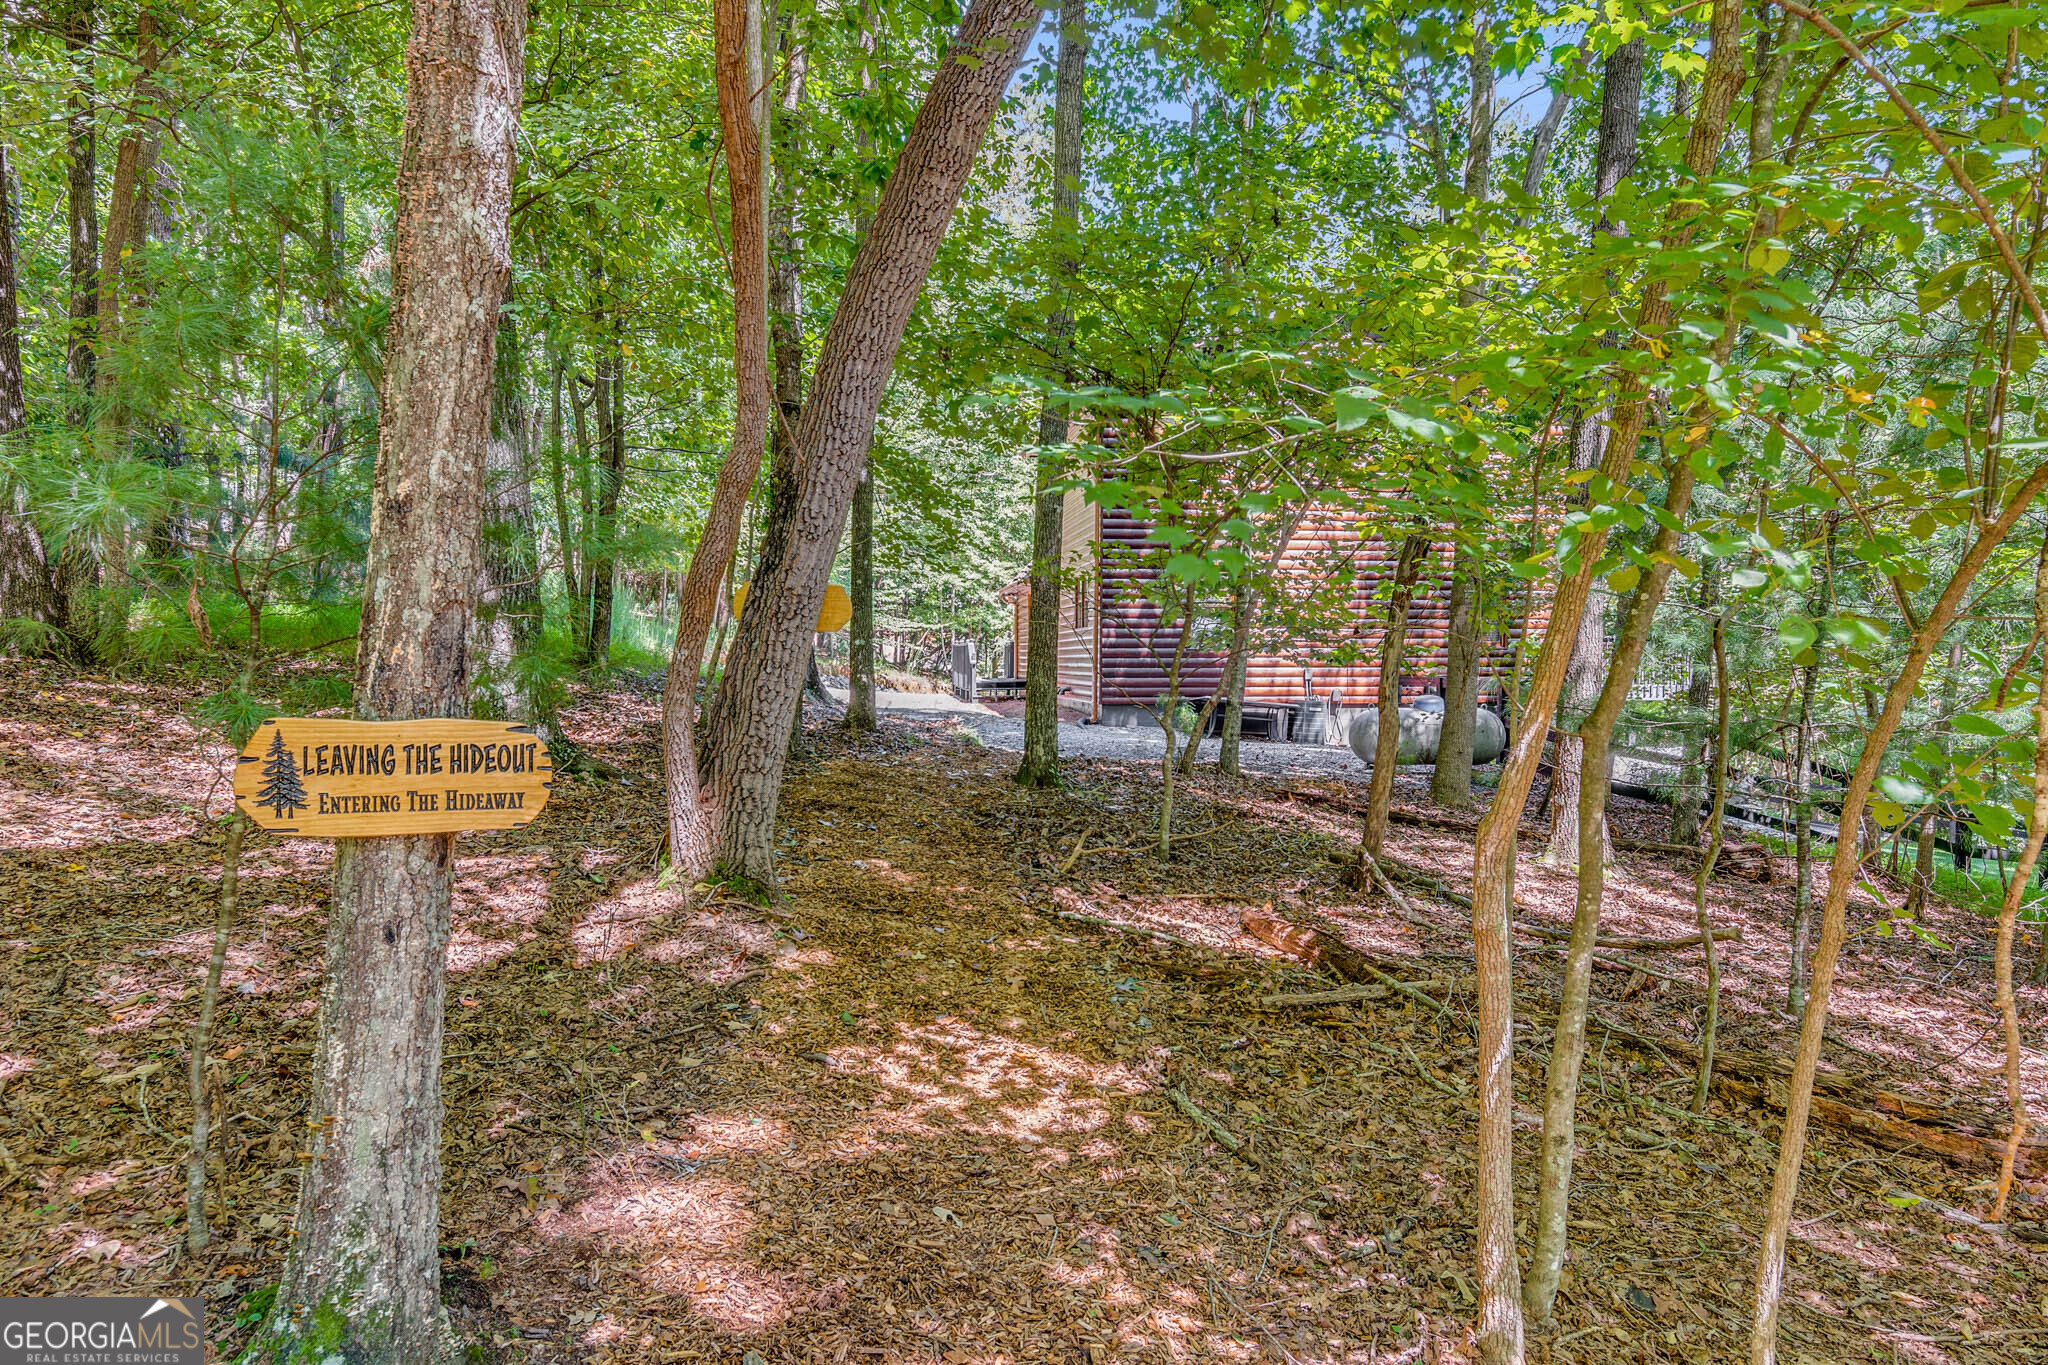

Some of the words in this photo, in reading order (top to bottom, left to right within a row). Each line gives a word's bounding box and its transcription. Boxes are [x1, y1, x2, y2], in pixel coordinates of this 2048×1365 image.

[303, 744, 395, 776] LEAVING
[403, 743, 442, 775] THE
[450, 743, 537, 775] HIDEOUT
